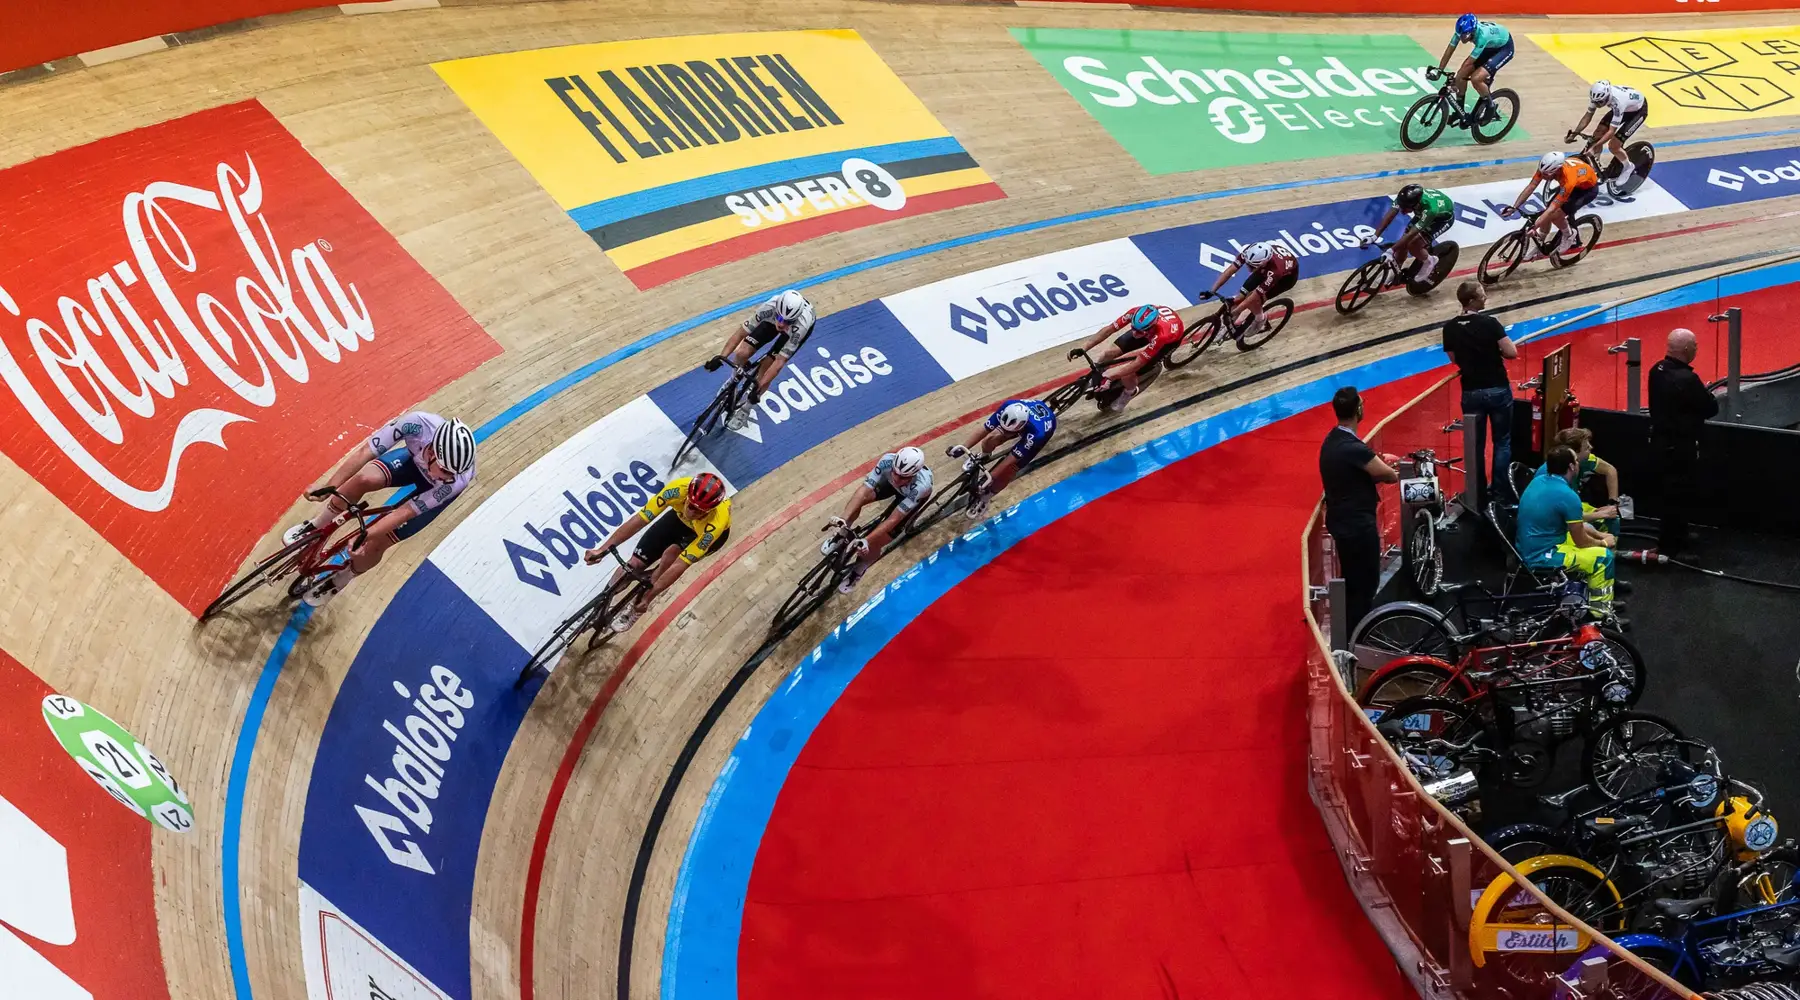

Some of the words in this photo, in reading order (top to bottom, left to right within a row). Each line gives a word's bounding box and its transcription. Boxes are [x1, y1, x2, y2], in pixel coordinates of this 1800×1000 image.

[544, 53, 844, 164] FLANDRIEN
[1063, 54, 1439, 108] Schneider
[724, 176, 860, 228] SUPER
[855, 169, 892, 198] 8
[976, 271, 1130, 331] baloise
[523, 458, 666, 571] baloise
[48, 697, 76, 715] 21
[94, 740, 141, 779] 21
[364, 663, 475, 836] baloise
[160, 808, 191, 831] 21
